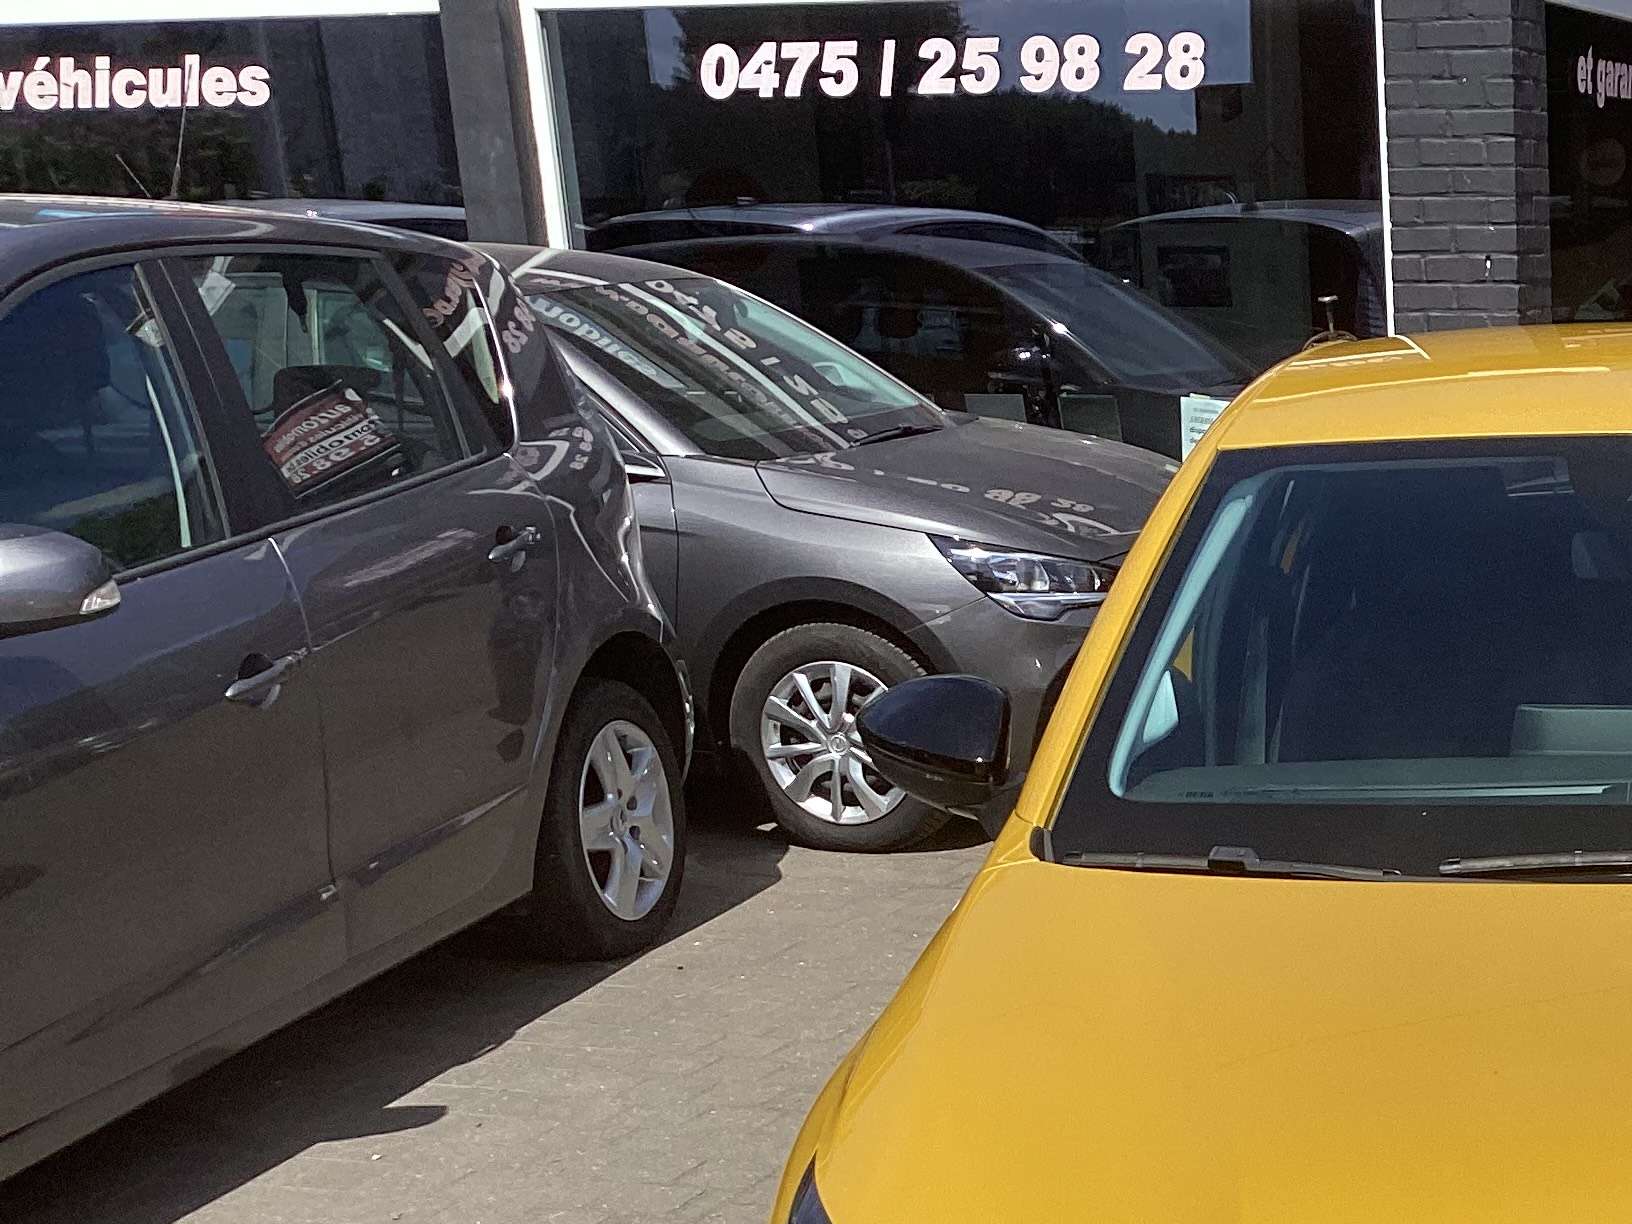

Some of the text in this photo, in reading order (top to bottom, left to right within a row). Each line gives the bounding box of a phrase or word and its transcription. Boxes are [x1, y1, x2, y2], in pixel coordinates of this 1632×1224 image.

[0, 54, 272, 111] véhicules
[700, 40, 859, 100] 0475
[917, 37, 1000, 95] 25
[1019, 34, 1100, 93] 98
[1123, 31, 1206, 91] 28
[1577, 44, 1593, 95] et
